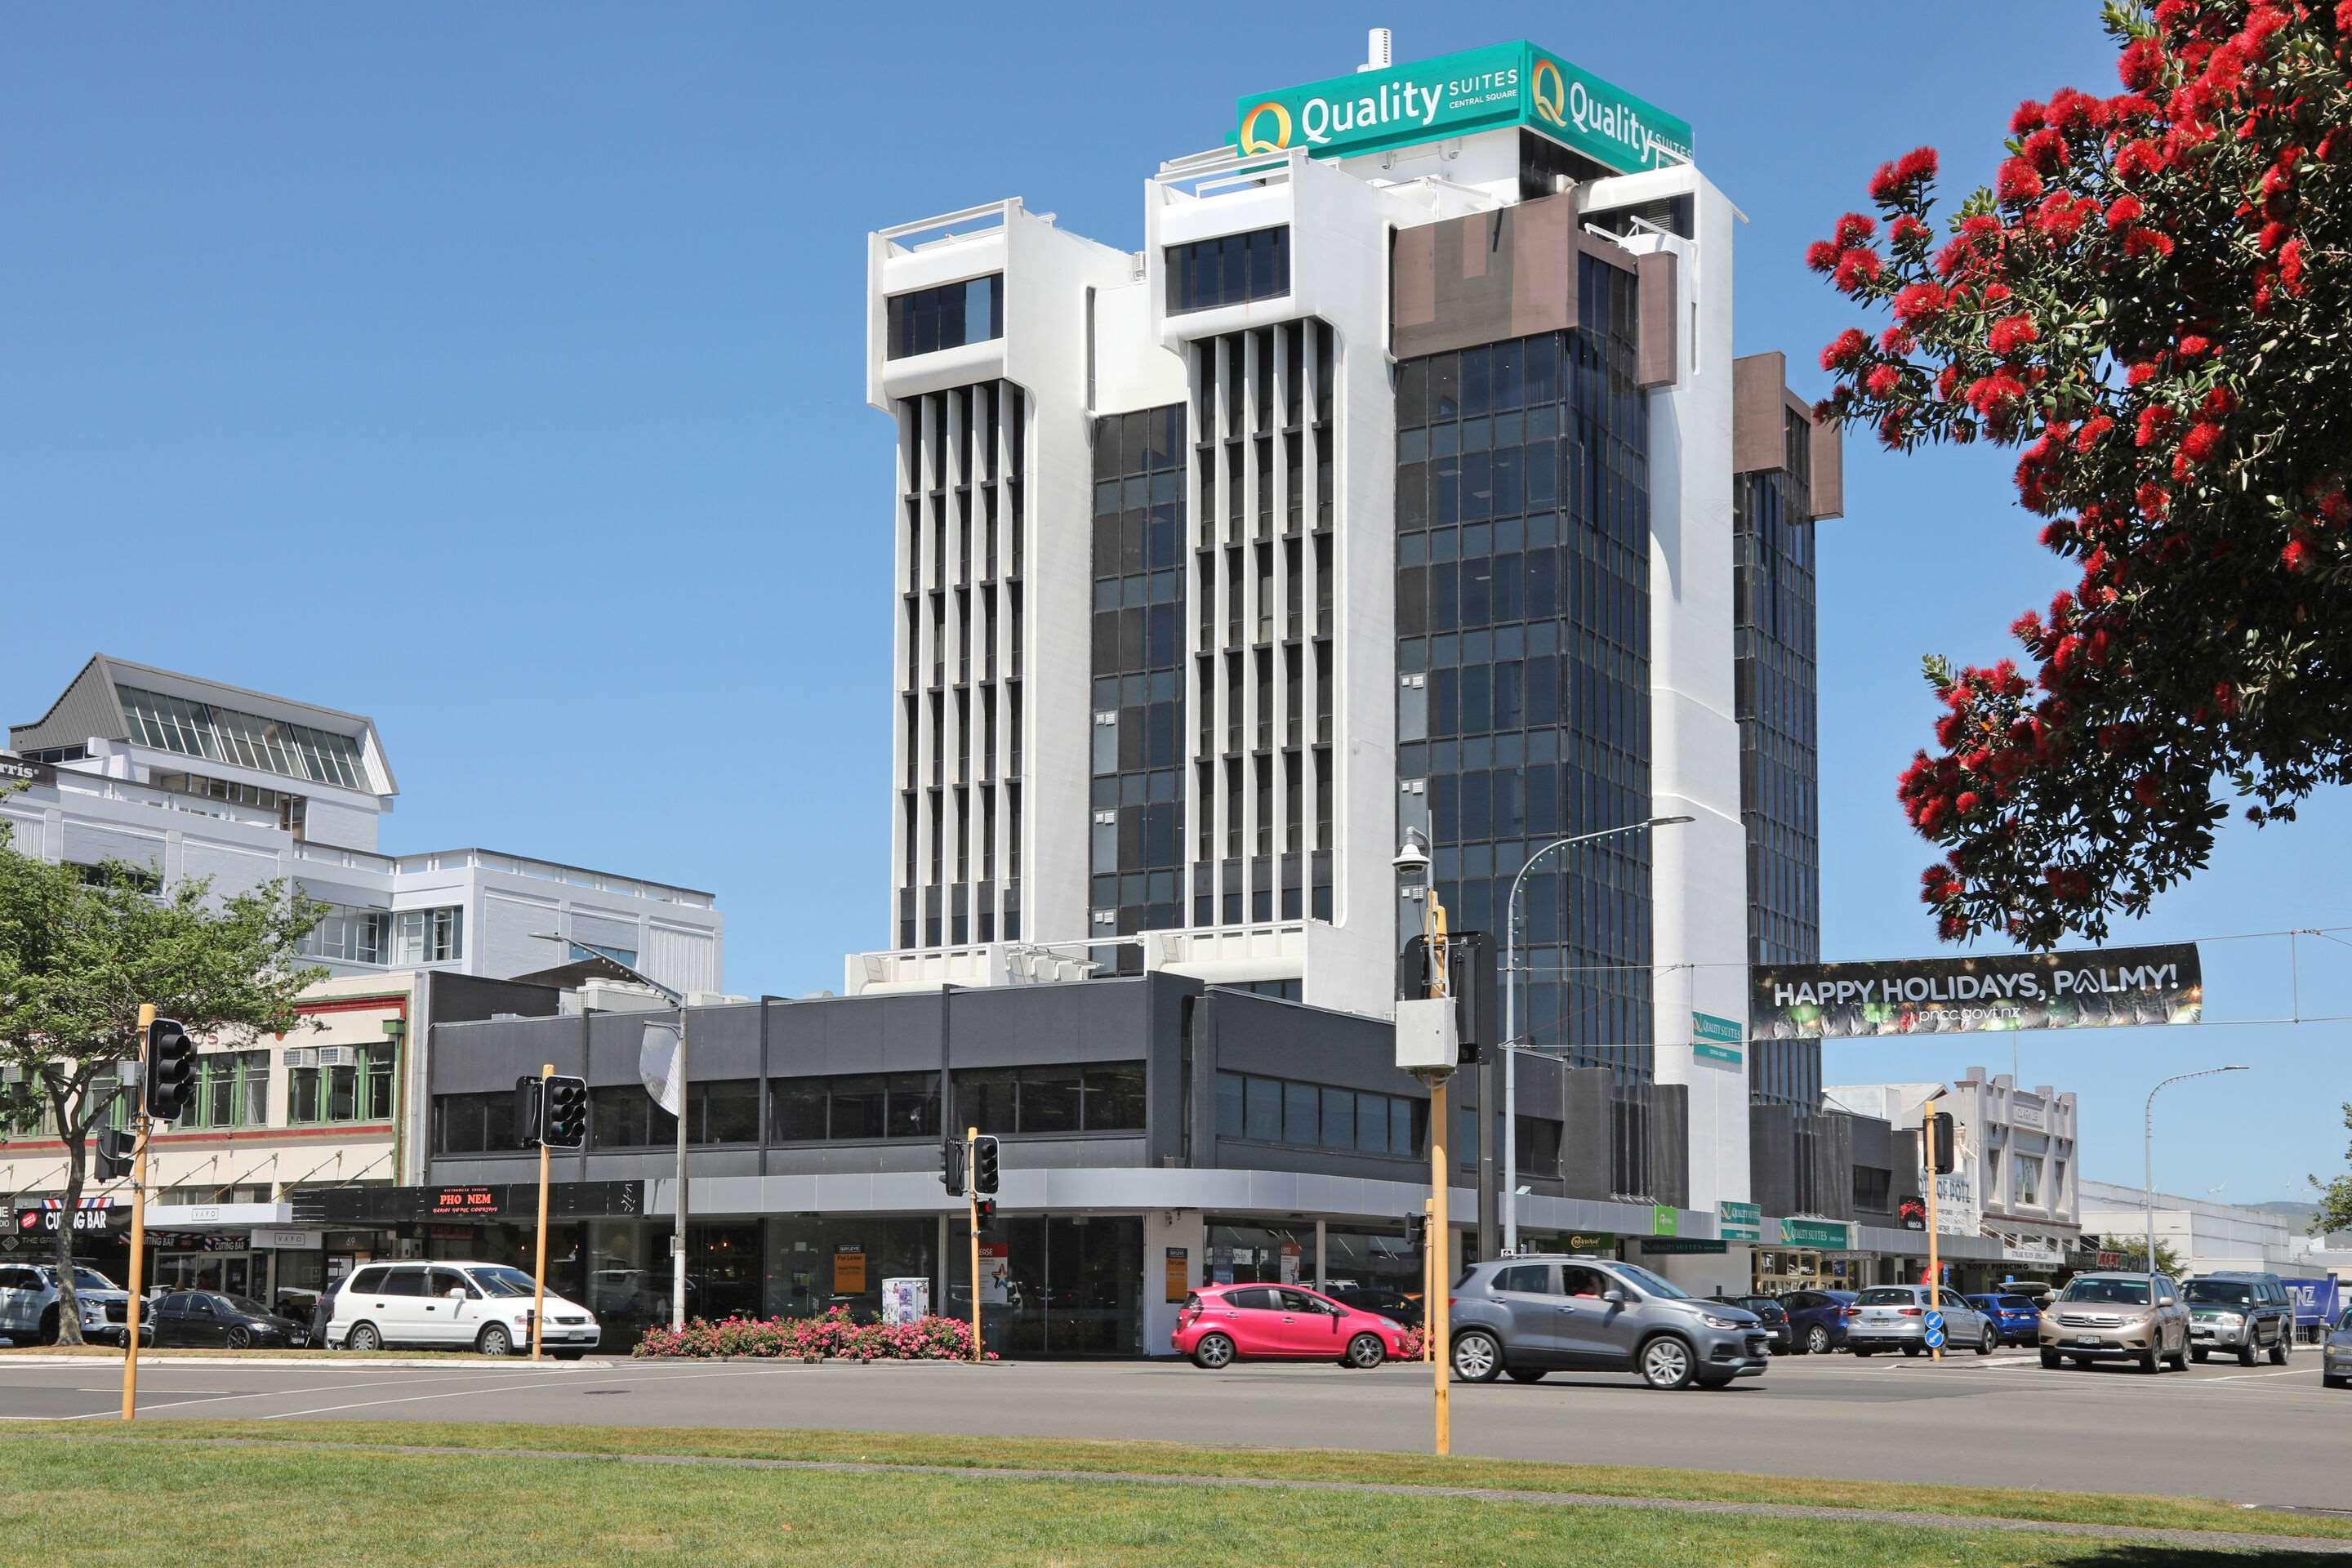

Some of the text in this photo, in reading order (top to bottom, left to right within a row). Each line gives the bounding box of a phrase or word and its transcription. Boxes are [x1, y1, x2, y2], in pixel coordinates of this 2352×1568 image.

[1302, 82, 1443, 144] Quality
[1449, 69, 1518, 96] SUITES
[1449, 88, 1518, 109] CENTRAL SQUARE
[1570, 82, 1653, 163] Quality
[1775, 964, 2180, 1007] HAPPY HOLIDAYS, PALMY!
[1919, 1006, 2021, 1022] pncc.govt.nz
[439, 1193, 492, 1205] PHO NEM
[87, 1210, 106, 1229] BAR
[144, 1236, 162, 1245] UTTING
[215, 1241, 245, 1250] CUTTING BAR
[978, 1248, 993, 1256] EASE
